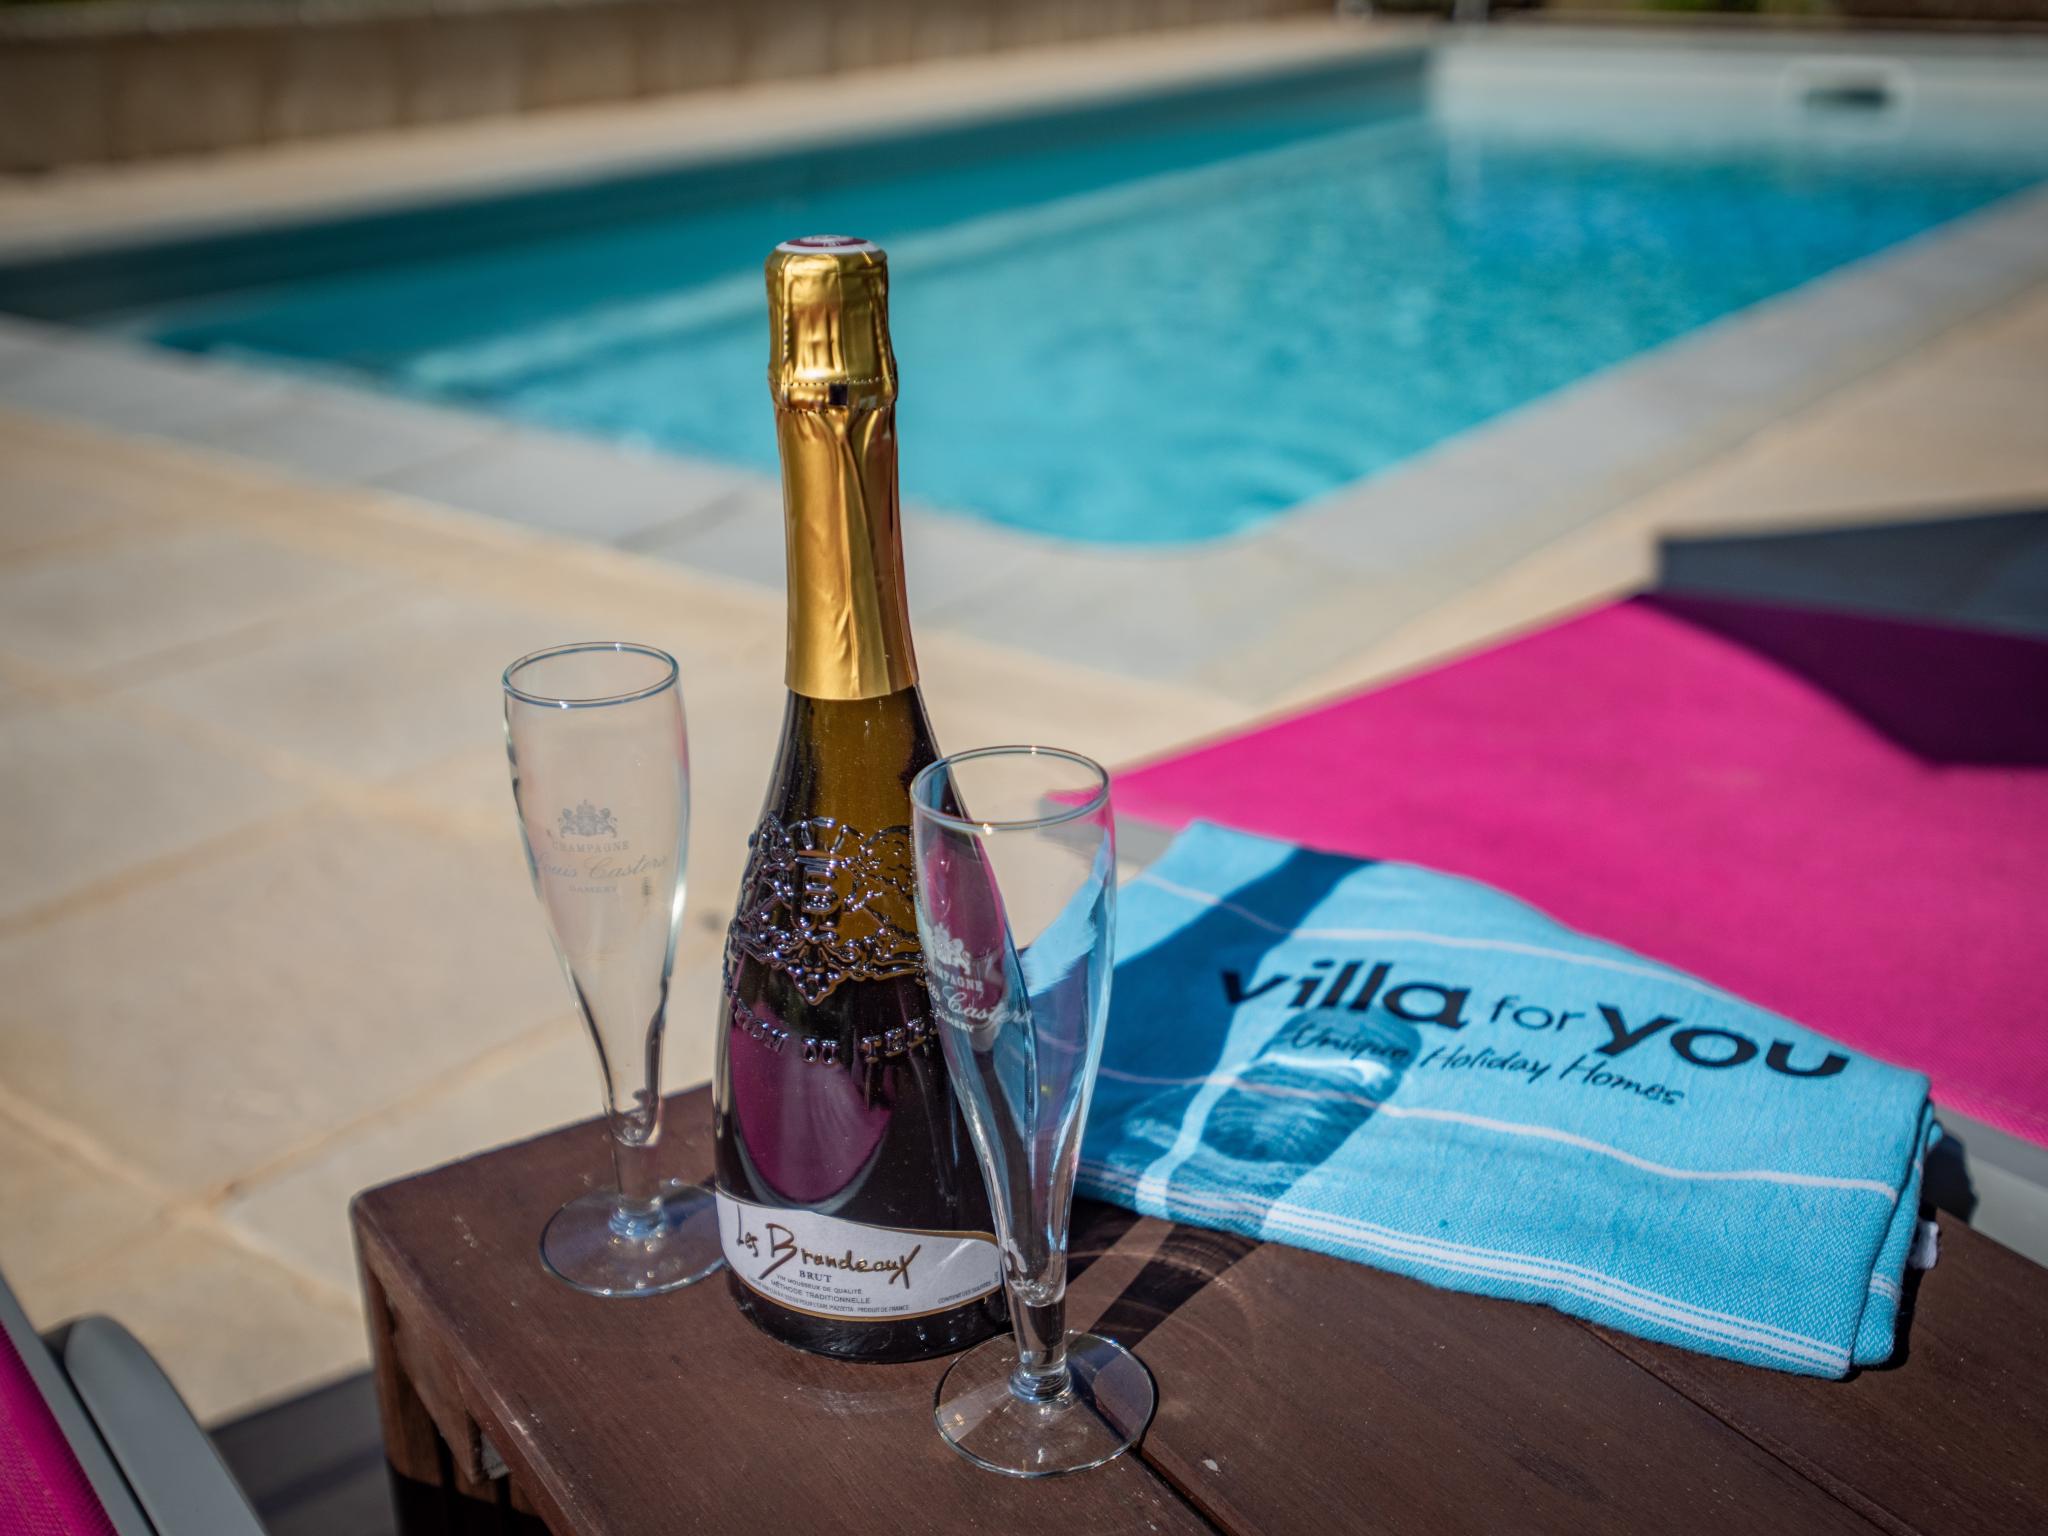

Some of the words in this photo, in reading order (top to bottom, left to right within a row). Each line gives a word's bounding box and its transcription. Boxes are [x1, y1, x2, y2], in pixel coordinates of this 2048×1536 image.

[1219, 960, 1471, 1030] villa
[1490, 995, 1585, 1031] for
[1594, 1002, 1850, 1077] you
[1288, 1021, 1409, 1059] Unique
[1419, 1046, 1550, 1084] Holiday
[1559, 1054, 1685, 1105] Homes
[799, 1269, 832, 1283] BRUT
[806, 1291, 871, 1304] TRADITIONNELLE
